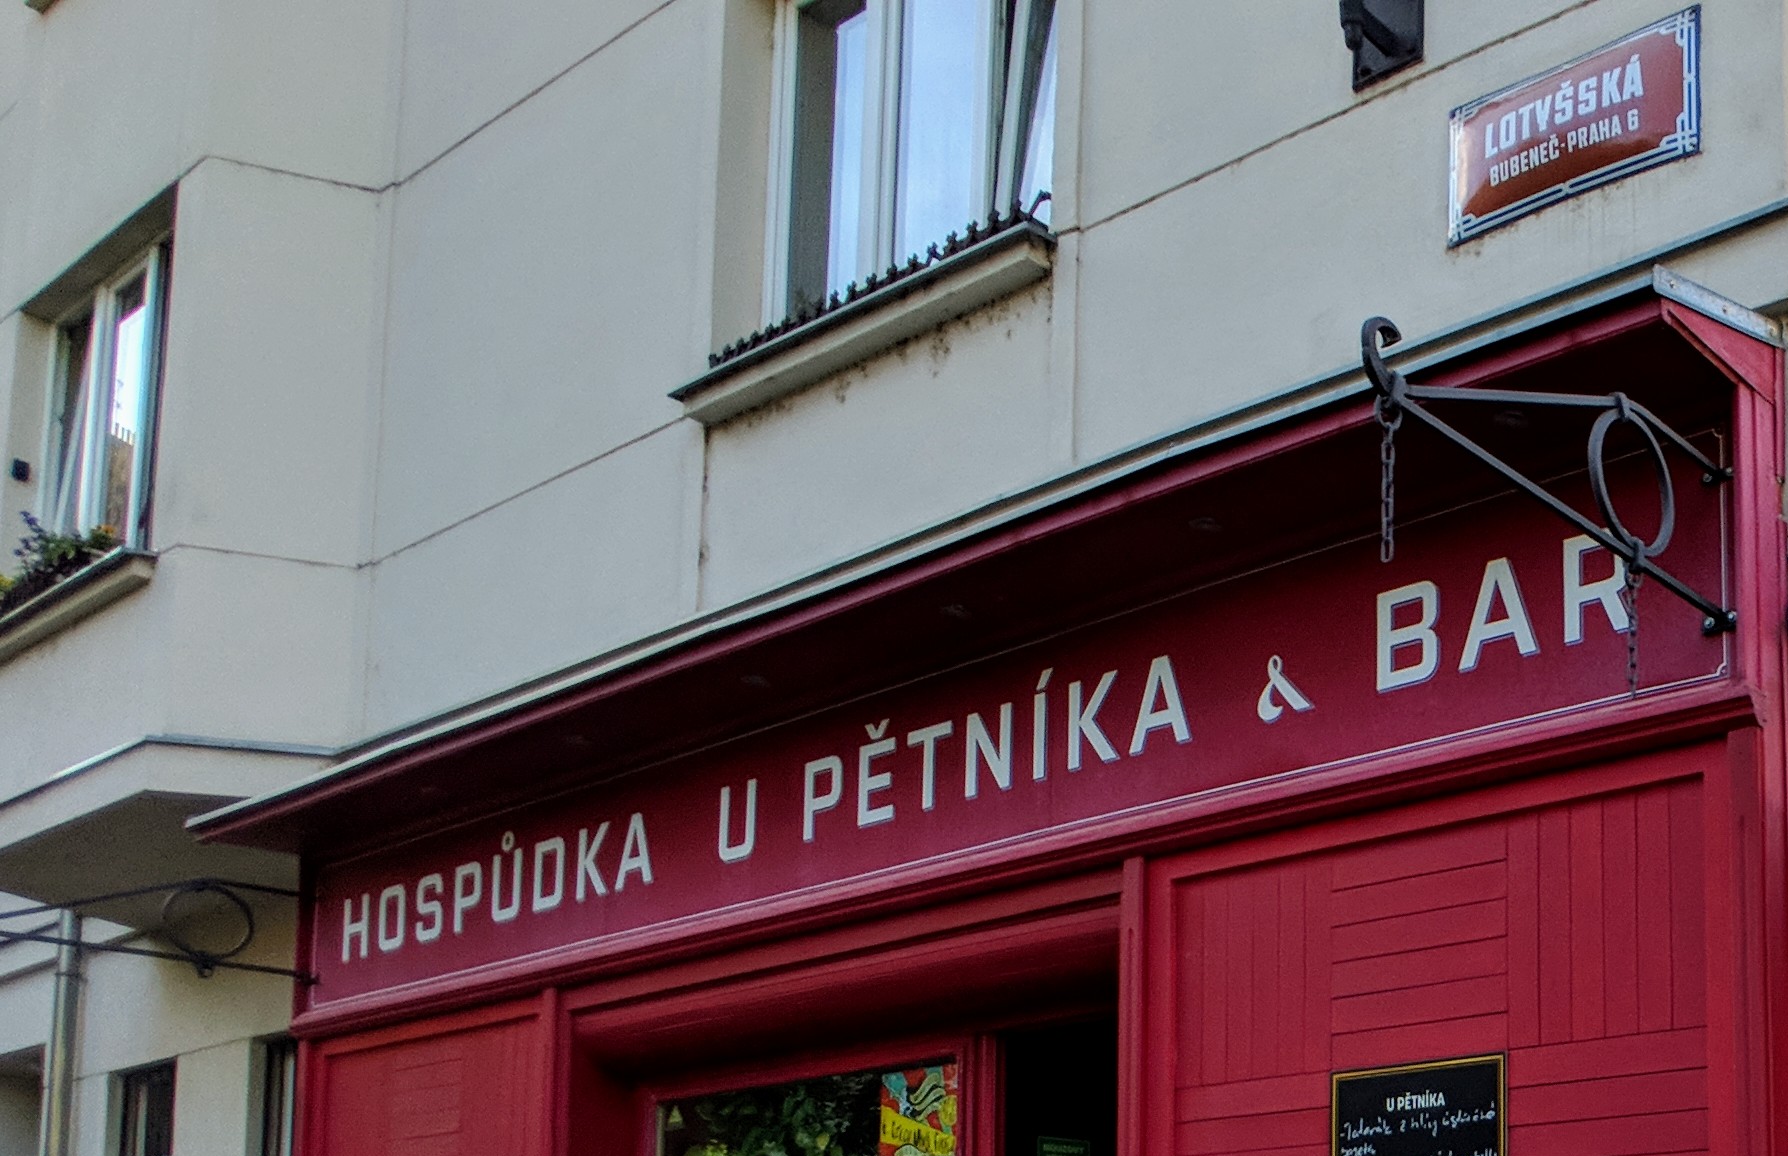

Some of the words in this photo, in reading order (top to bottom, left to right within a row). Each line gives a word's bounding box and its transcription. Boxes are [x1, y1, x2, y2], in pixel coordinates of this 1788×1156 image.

[1484, 53, 1645, 159] LOTYŠSKÁ
[1626, 108, 1640, 132] 6
[341, 812, 654, 963] HOSPŮDKA
[718, 778, 758, 863] U
[803, 655, 1192, 842] PĚTNÍKA
[1257, 655, 1315, 723] &
[1376, 528, 1632, 694] BAR
[1386, 1097, 1395, 1112] U
[1397, 1089, 1446, 1111] PĚTNÍKA
